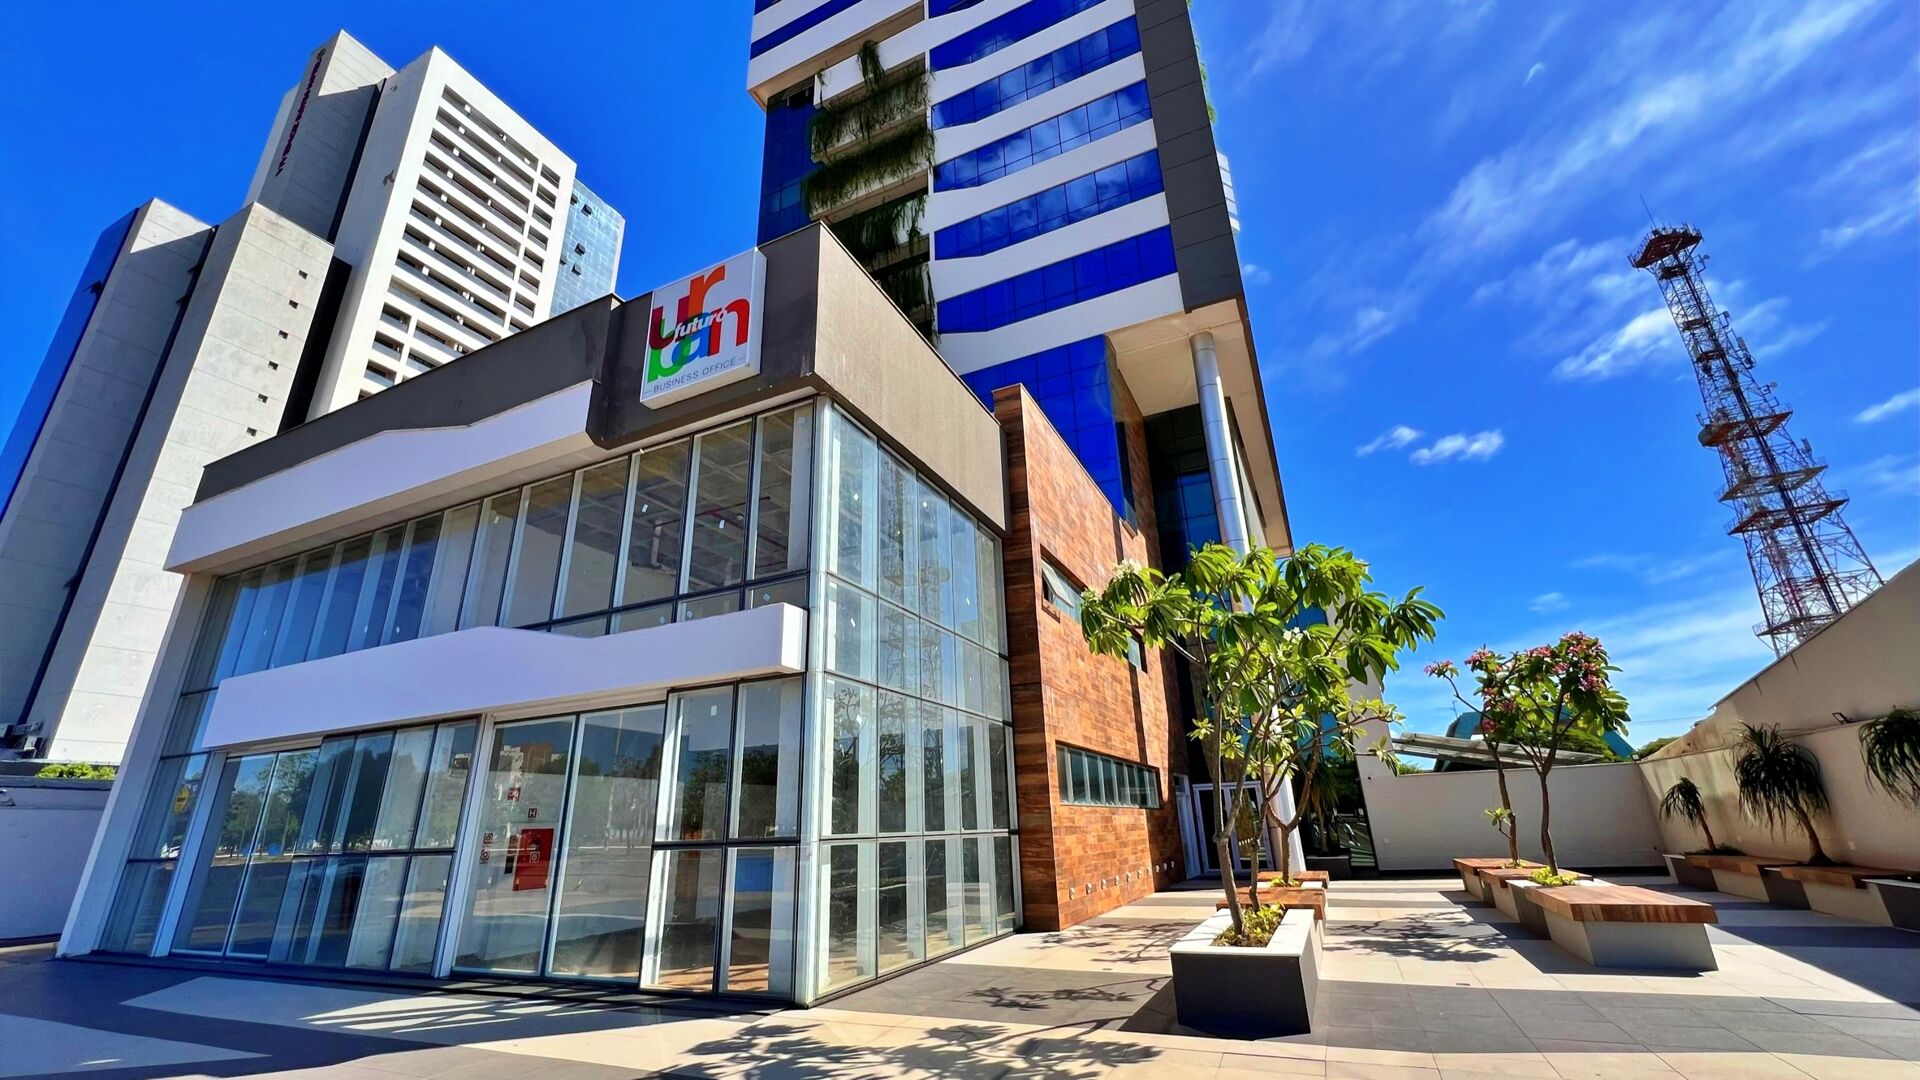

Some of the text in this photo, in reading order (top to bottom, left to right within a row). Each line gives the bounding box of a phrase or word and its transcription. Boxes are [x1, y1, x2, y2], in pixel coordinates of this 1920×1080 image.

[672, 309, 727, 342] futuro
[653, 357, 736, 393] BUSINESS OFFICE
